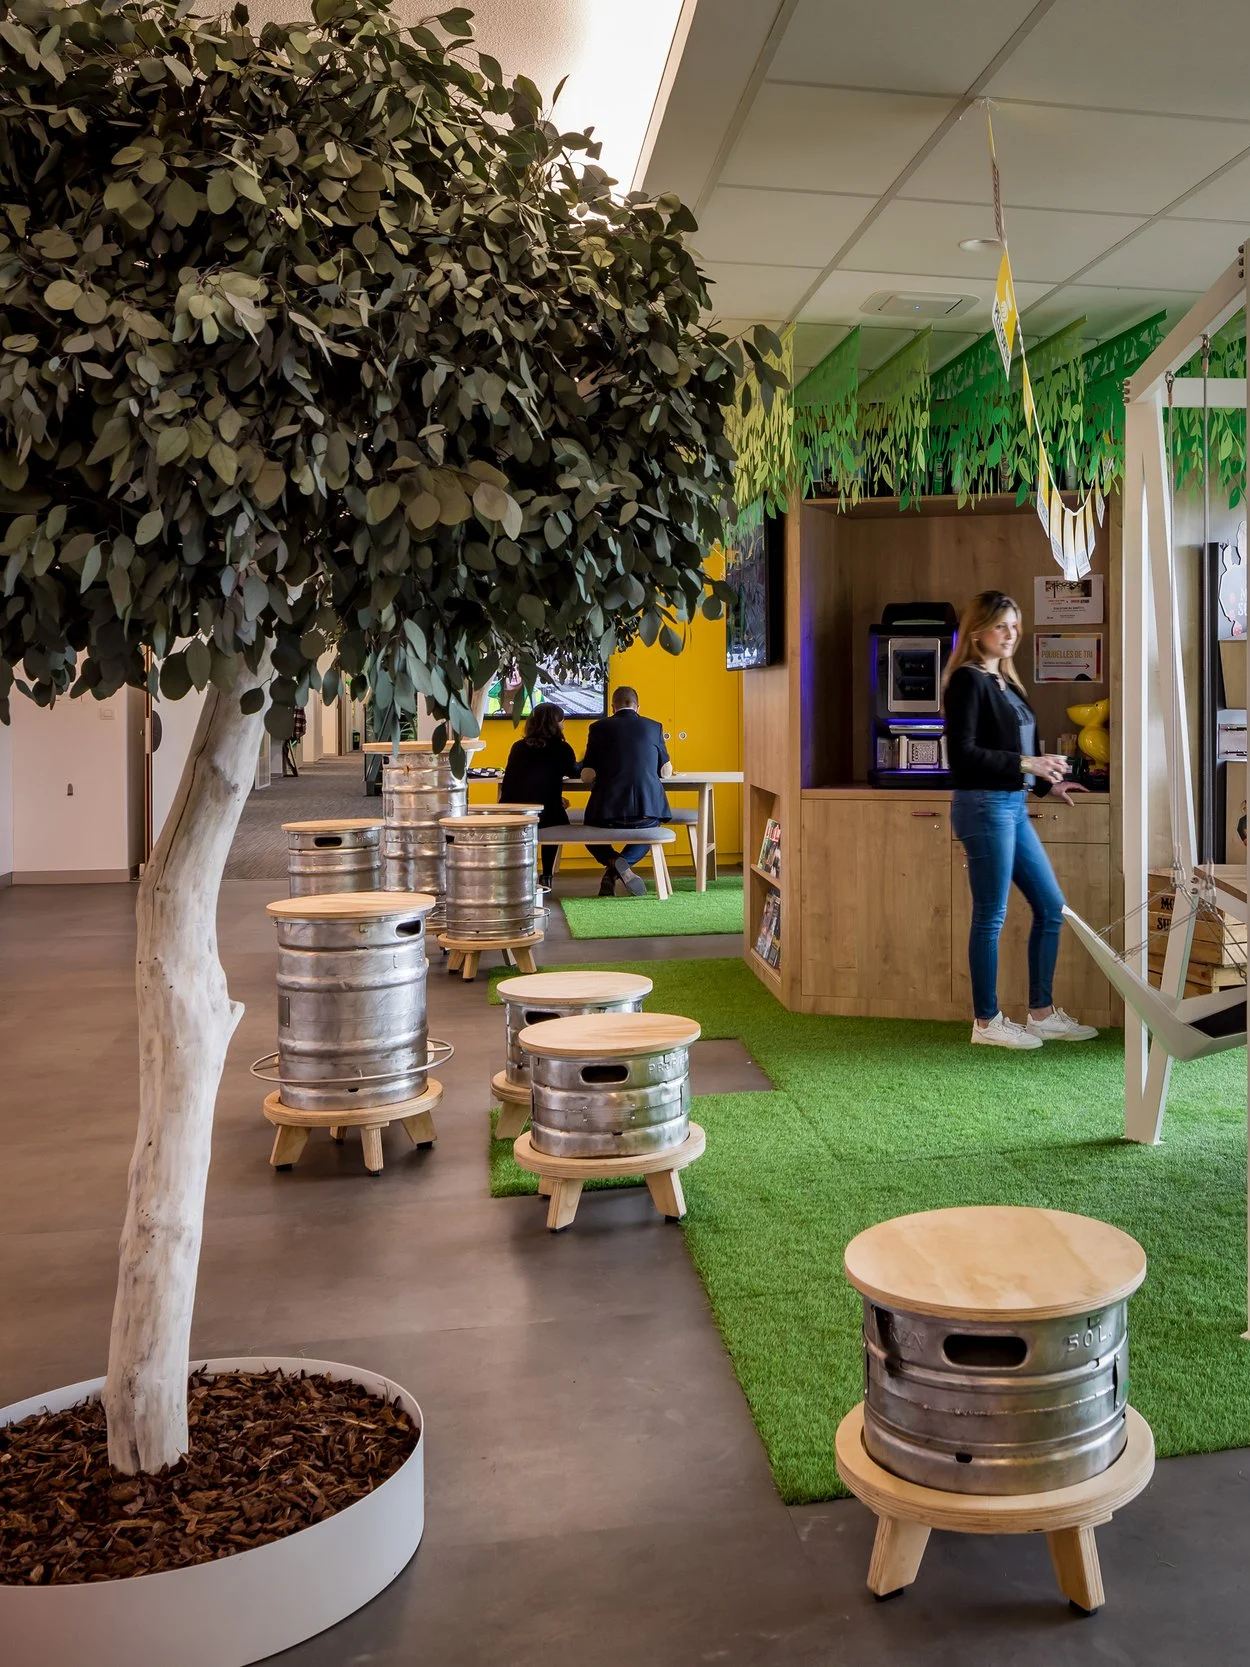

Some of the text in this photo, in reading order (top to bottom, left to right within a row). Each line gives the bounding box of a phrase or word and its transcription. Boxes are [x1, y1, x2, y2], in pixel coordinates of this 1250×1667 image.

[1041, 650, 1093, 659] POUBELLES DE TRI
